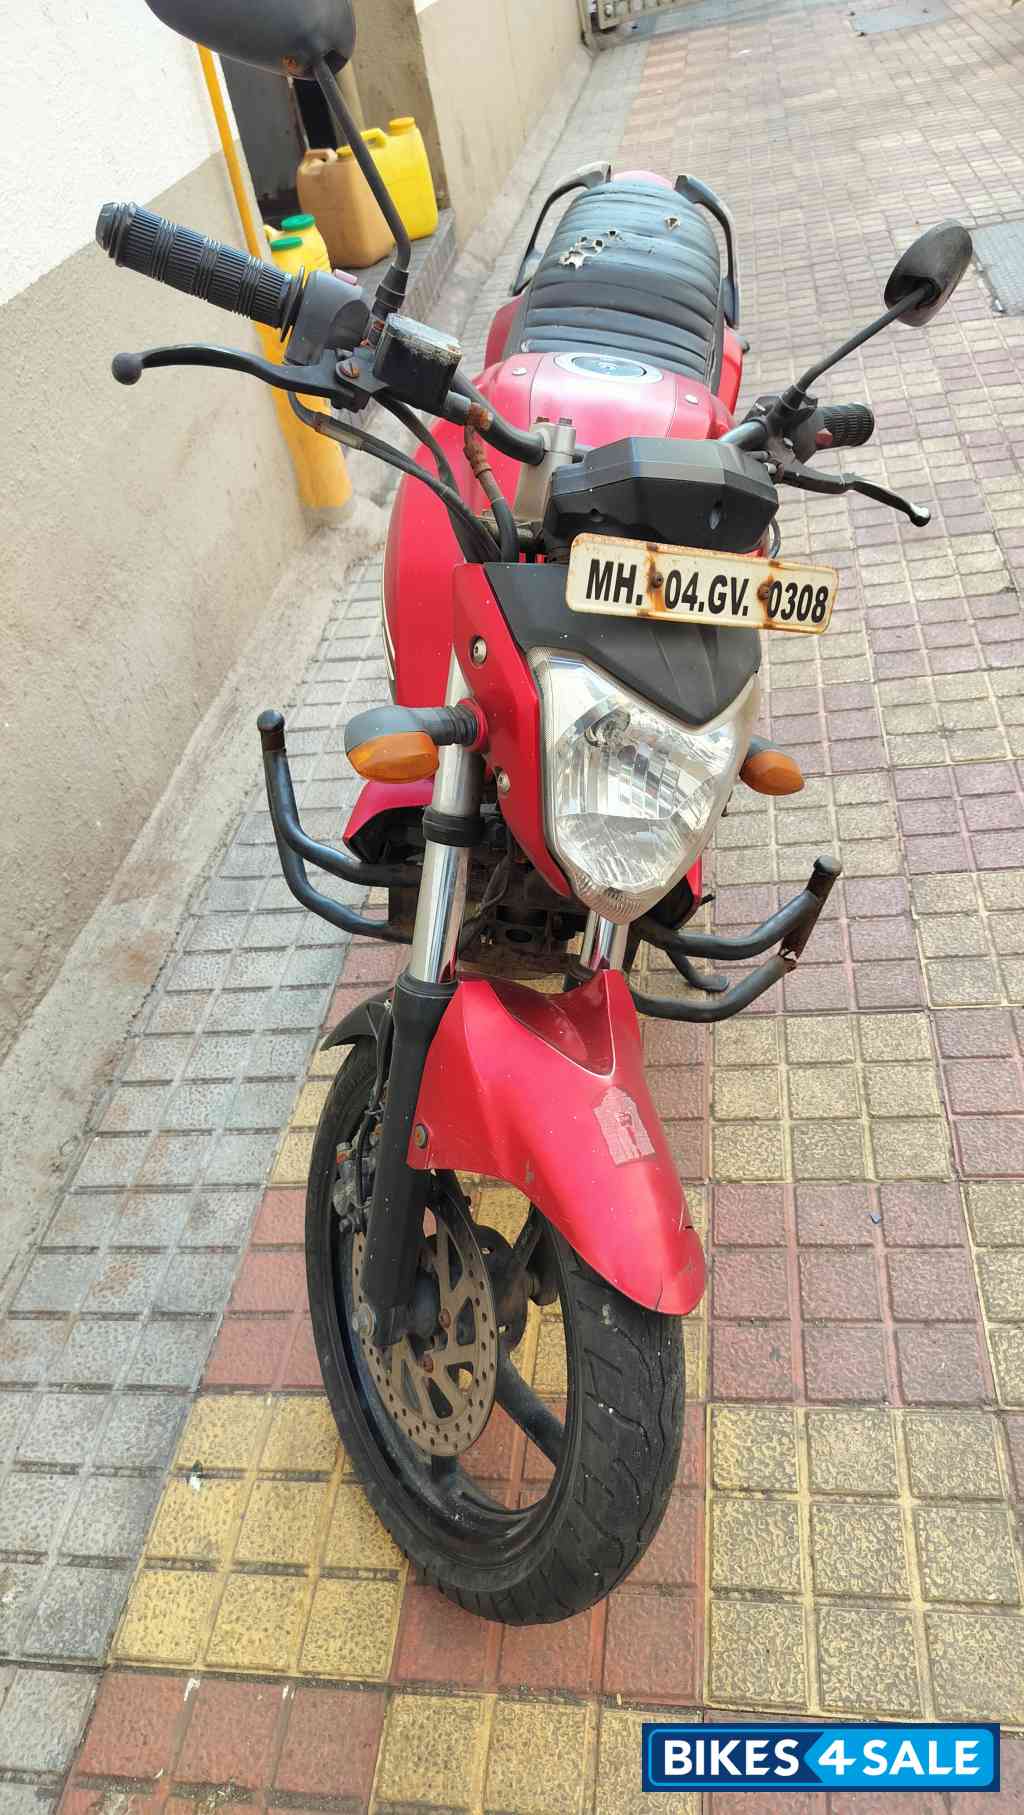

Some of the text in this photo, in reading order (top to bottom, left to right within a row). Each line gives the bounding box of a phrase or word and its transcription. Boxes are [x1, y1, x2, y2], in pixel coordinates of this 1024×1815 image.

[586, 559, 829, 623] MH. 04.GV. 0308
